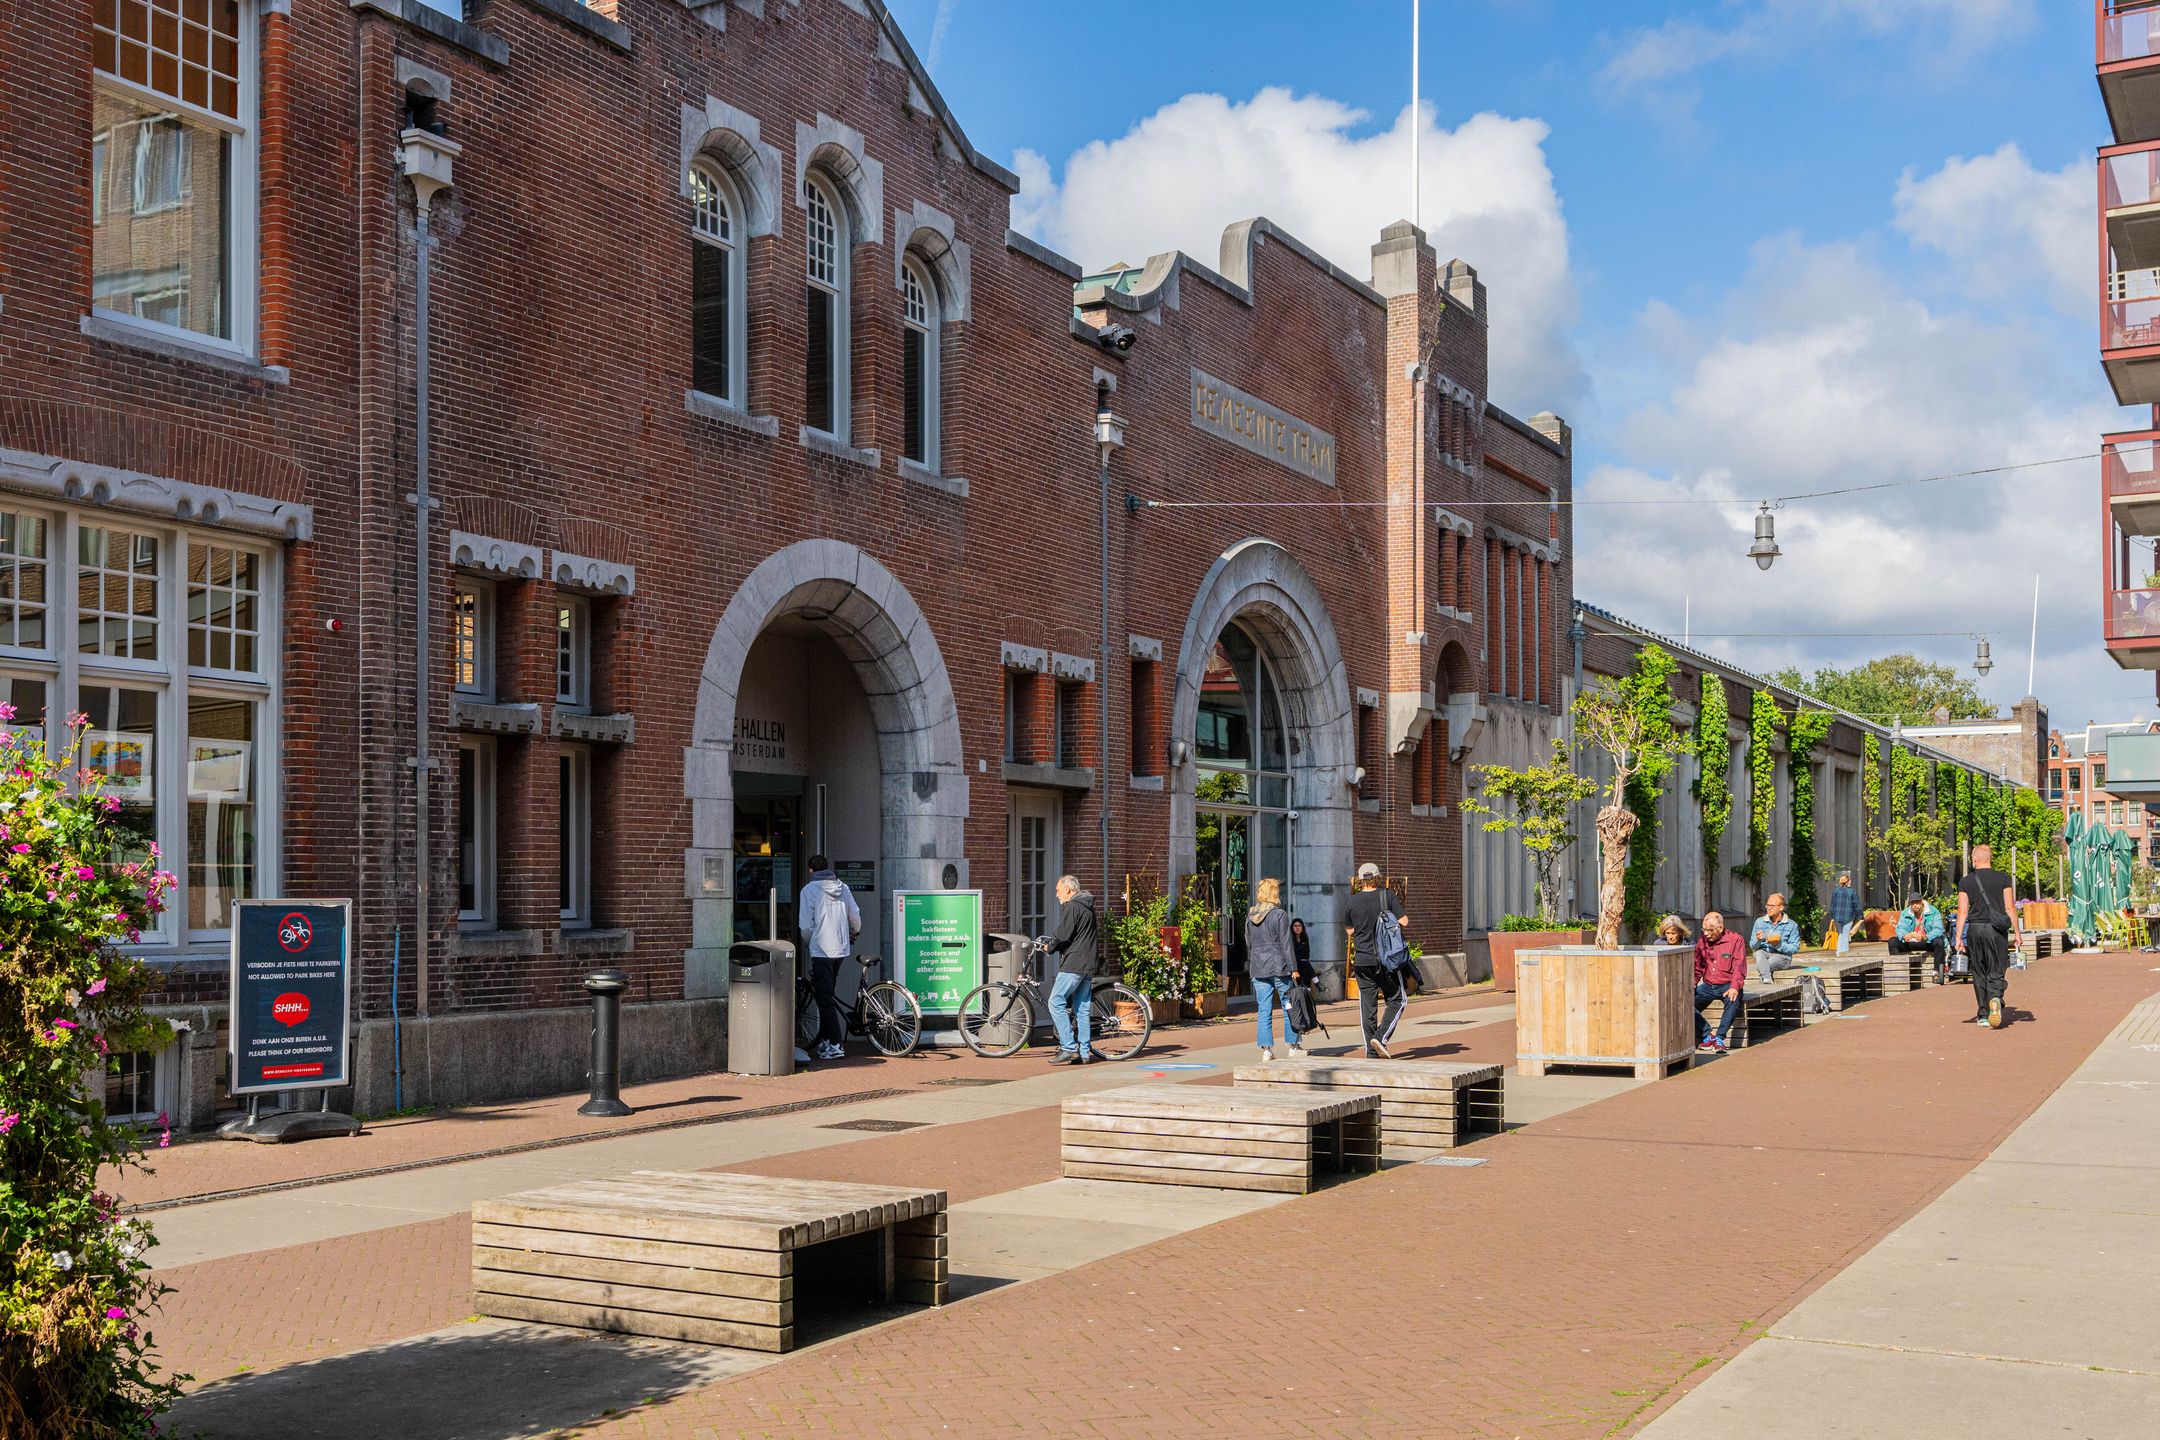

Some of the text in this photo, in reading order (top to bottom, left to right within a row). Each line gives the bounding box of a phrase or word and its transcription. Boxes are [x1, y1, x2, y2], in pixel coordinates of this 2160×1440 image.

[1196, 383, 1331, 474] GEMEENTE TRAM
[742, 718, 785, 742] HALLEN
[733, 742, 785, 760] MSTERDAM
[274, 1003, 309, 1013] SHHH...
